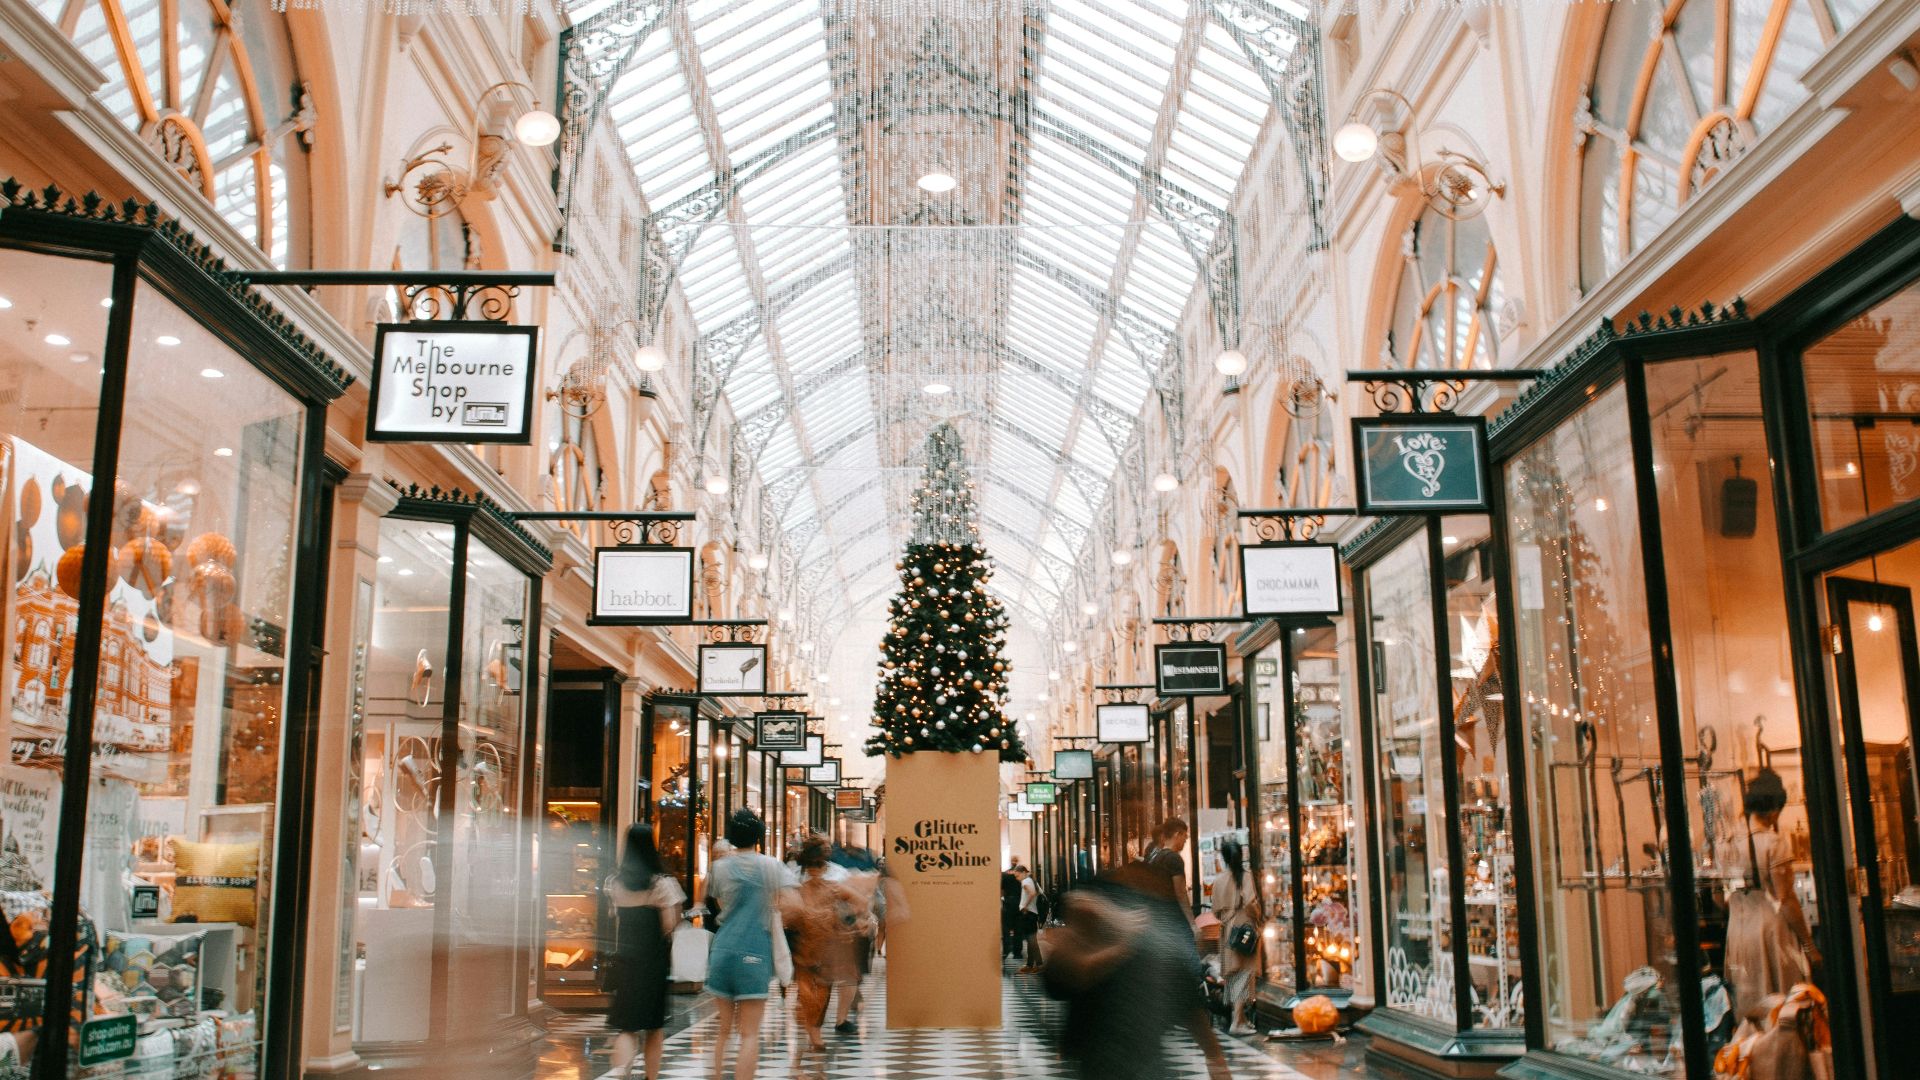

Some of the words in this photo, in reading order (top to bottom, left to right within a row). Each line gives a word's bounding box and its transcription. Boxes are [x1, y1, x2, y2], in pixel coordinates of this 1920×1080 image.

[417, 340, 455, 357] The
[393, 356, 514, 376] Melbourne
[411, 378, 467, 402] Shop
[432, 398, 458, 422] by
[1256, 578, 1320, 591] CHOCAMAMA
[608, 589, 677, 607] habbot.
[1163, 664, 1219, 677] WESTMINSTER
[894, 836, 964, 855] Sparkle
